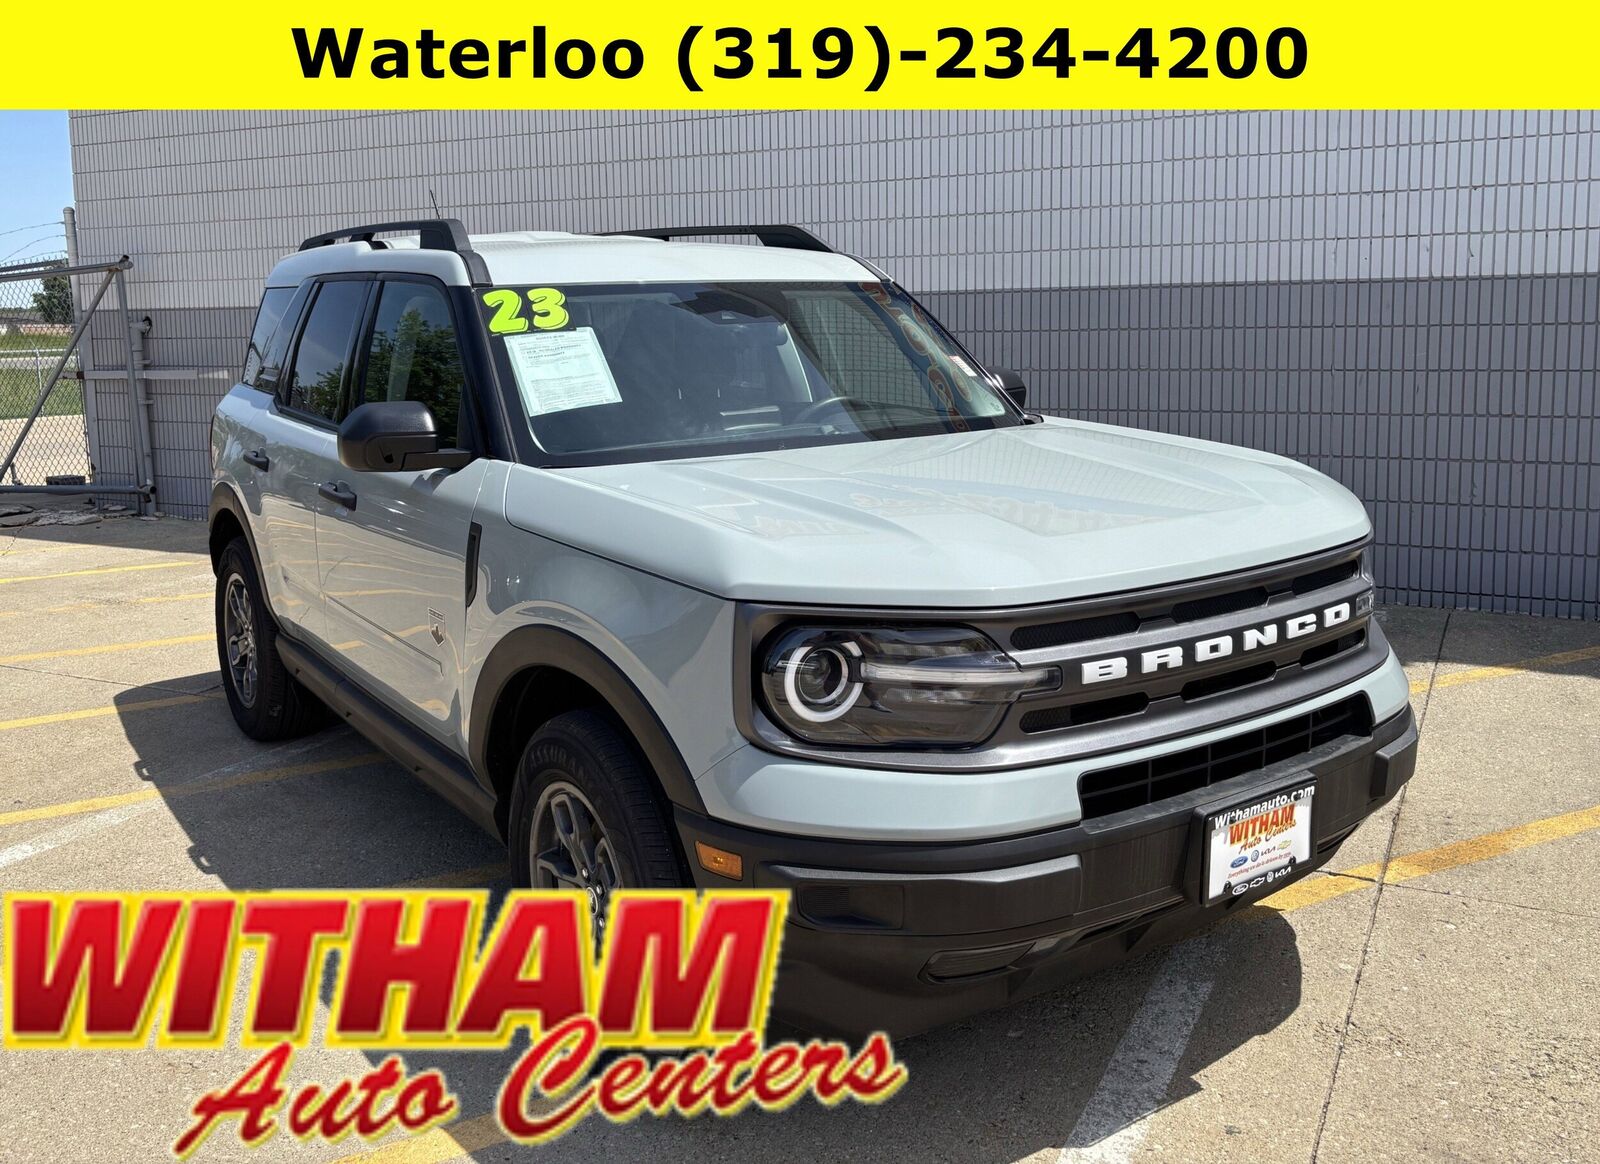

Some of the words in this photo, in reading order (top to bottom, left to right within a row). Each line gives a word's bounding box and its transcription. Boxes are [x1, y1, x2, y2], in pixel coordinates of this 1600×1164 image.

[482, 288, 569, 333] 23
[1081, 602, 1350, 685] BRONCO
[1229, 803, 1296, 845] WITHAM
[1239, 836, 1262, 854] Auto
[1265, 819, 1296, 842] Centers
